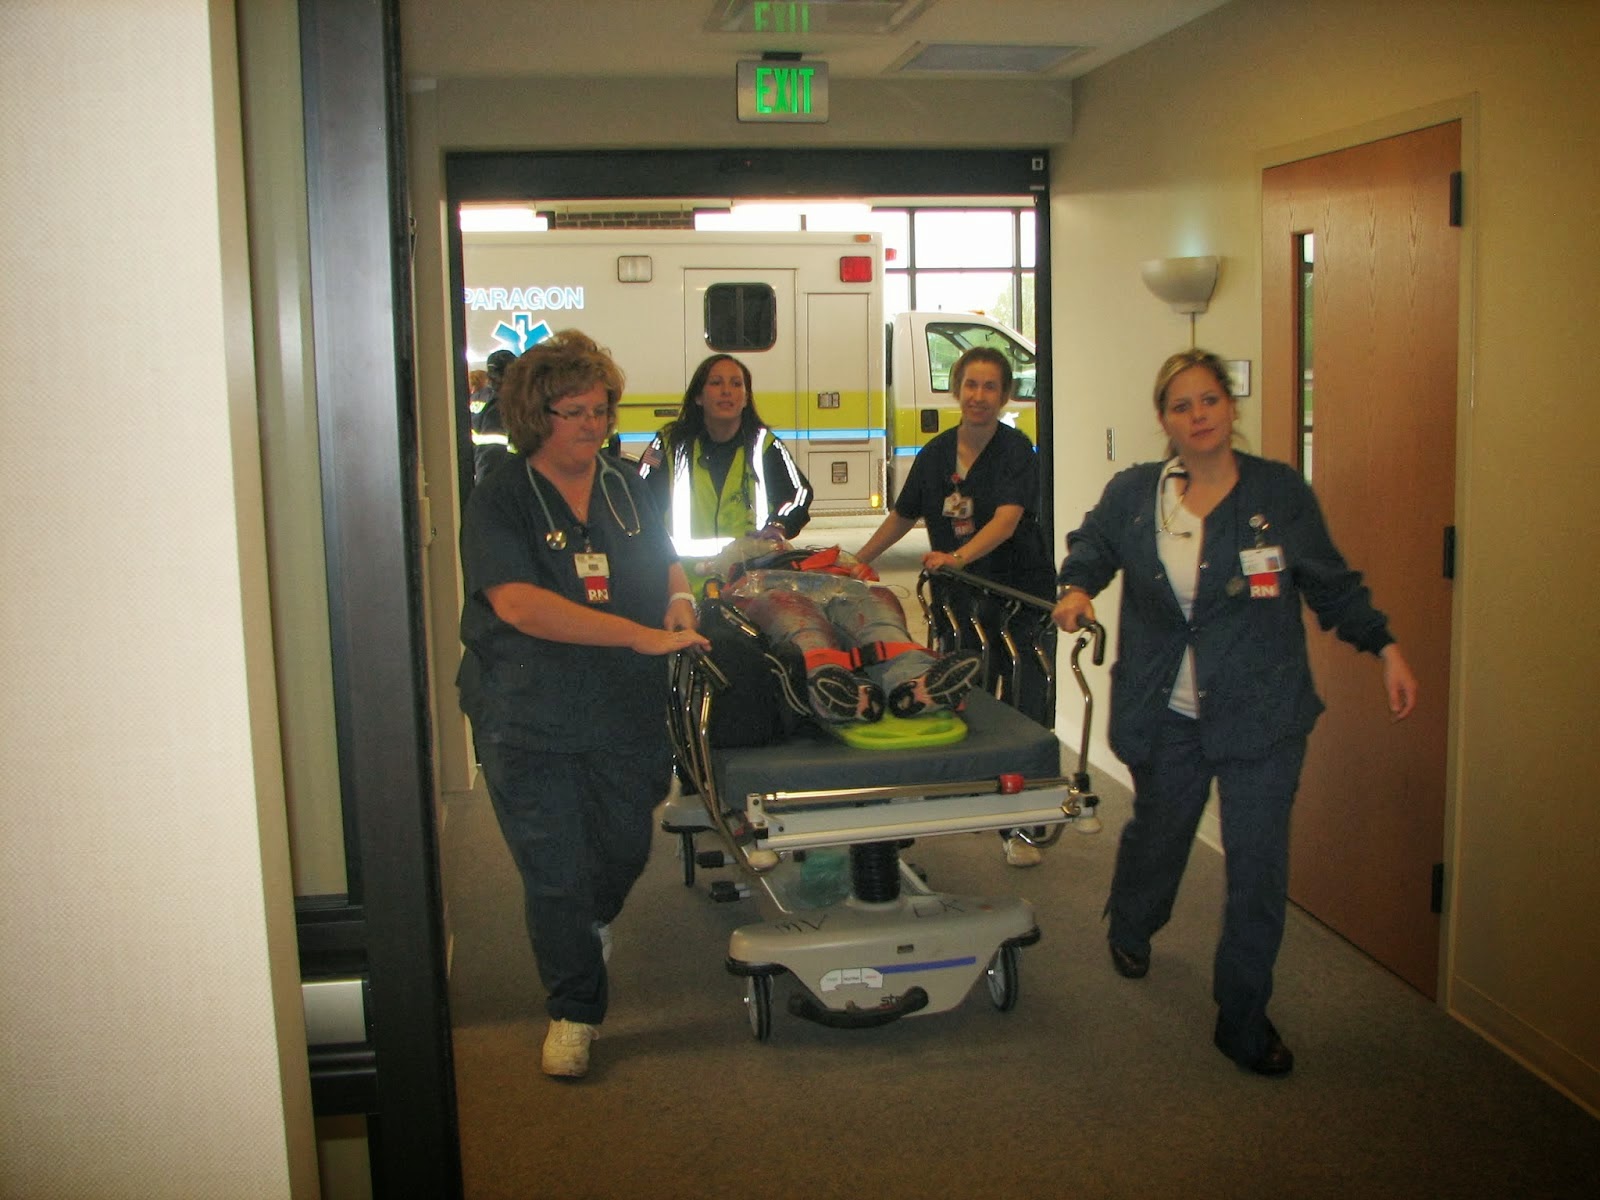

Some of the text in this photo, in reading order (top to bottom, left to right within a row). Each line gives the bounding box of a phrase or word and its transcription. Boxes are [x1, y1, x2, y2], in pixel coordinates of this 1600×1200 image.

[756, 67, 814, 113] EXIT
[464, 287, 584, 311] PARAGON
[588, 588, 609, 601] RN
[1250, 584, 1275, 598] RN
